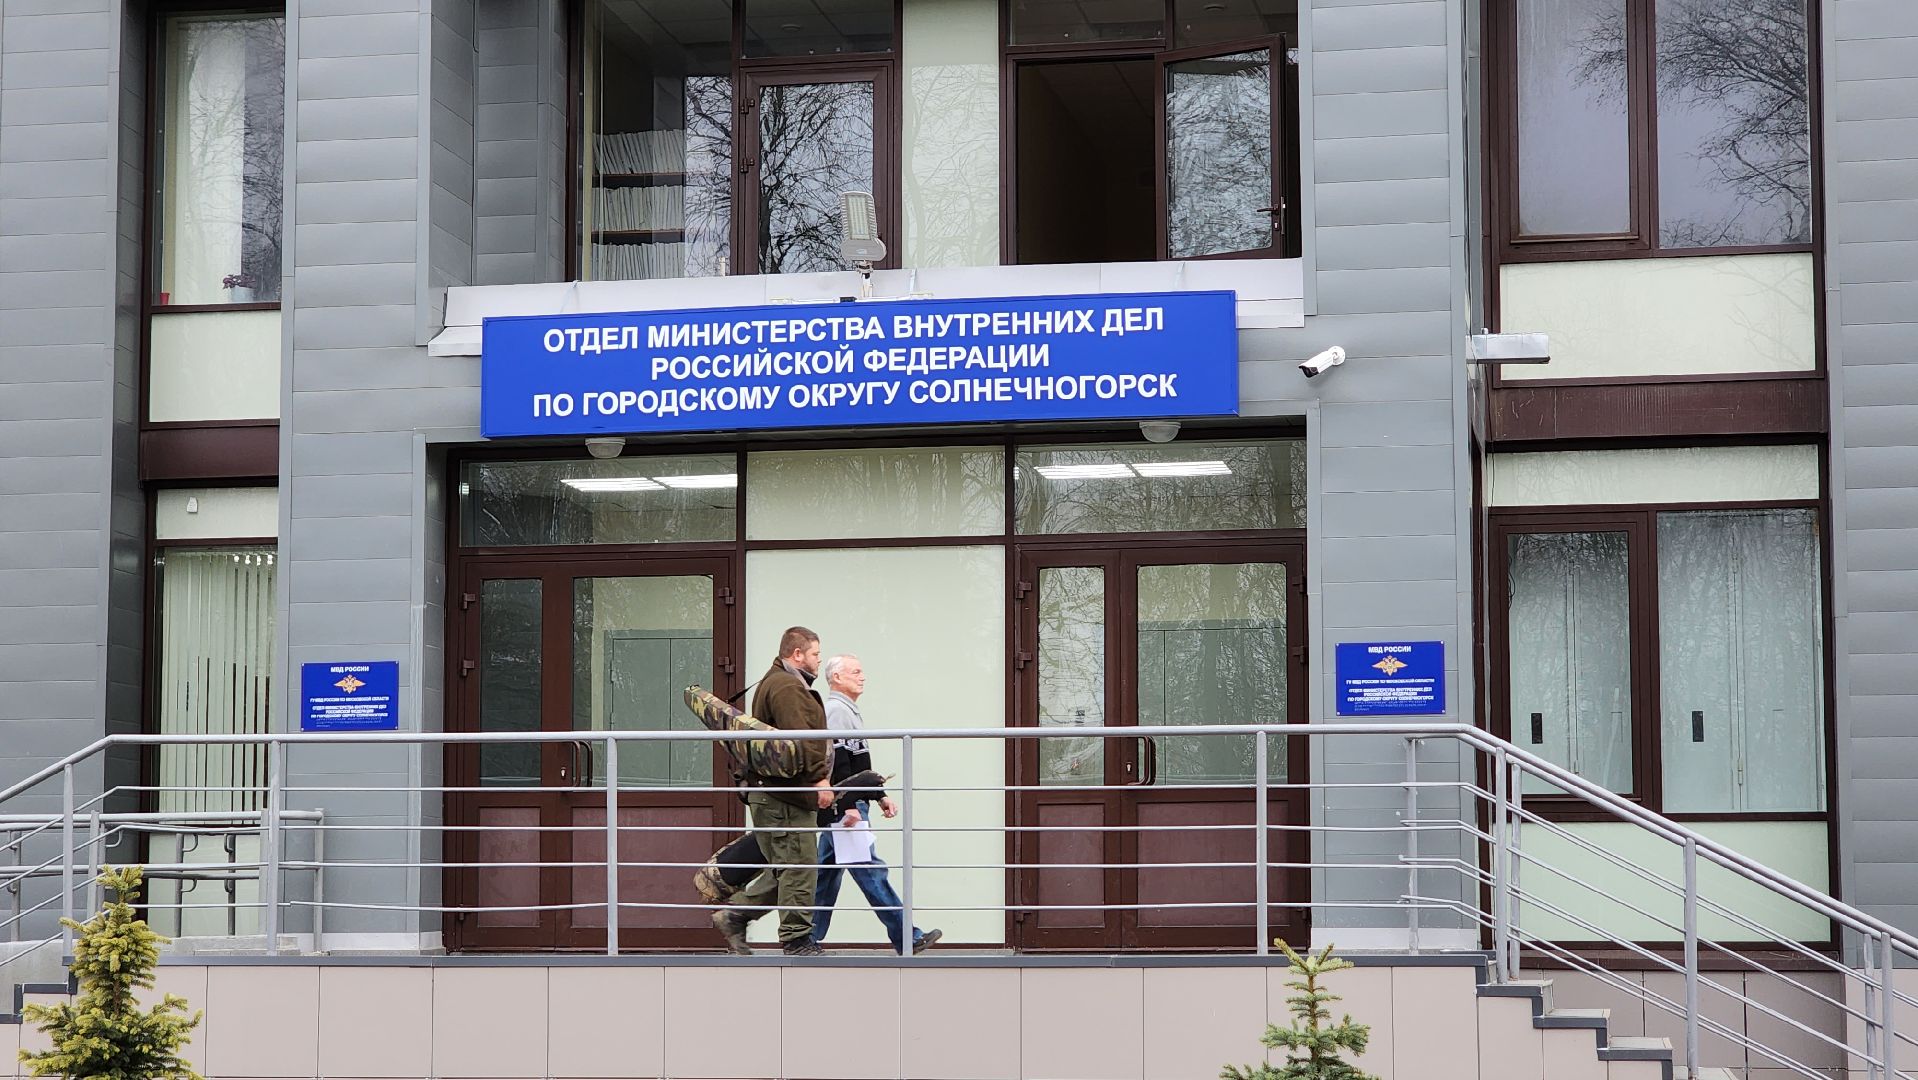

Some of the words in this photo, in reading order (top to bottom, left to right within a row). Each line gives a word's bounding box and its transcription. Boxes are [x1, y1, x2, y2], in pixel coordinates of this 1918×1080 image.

[543, 326, 639, 355] ОТДЕЛ
[647, 316, 886, 349] МИНИСТЕРСТВА
[893, 308, 1096, 339] ВНУТРЕННИХ
[1101, 306, 1164, 337] ДЕЛ
[651, 343, 854, 381] РОССИЙСКОЙ
[863, 343, 1050, 376] ФЕДЕРАЦИИ
[533, 393, 574, 418] ПО
[582, 384, 781, 418] ГОРОДСКОМУ
[788, 379, 901, 409] ОКРУГУ
[909, 373, 1178, 404] СОЛНЕЧНОГОРСК
